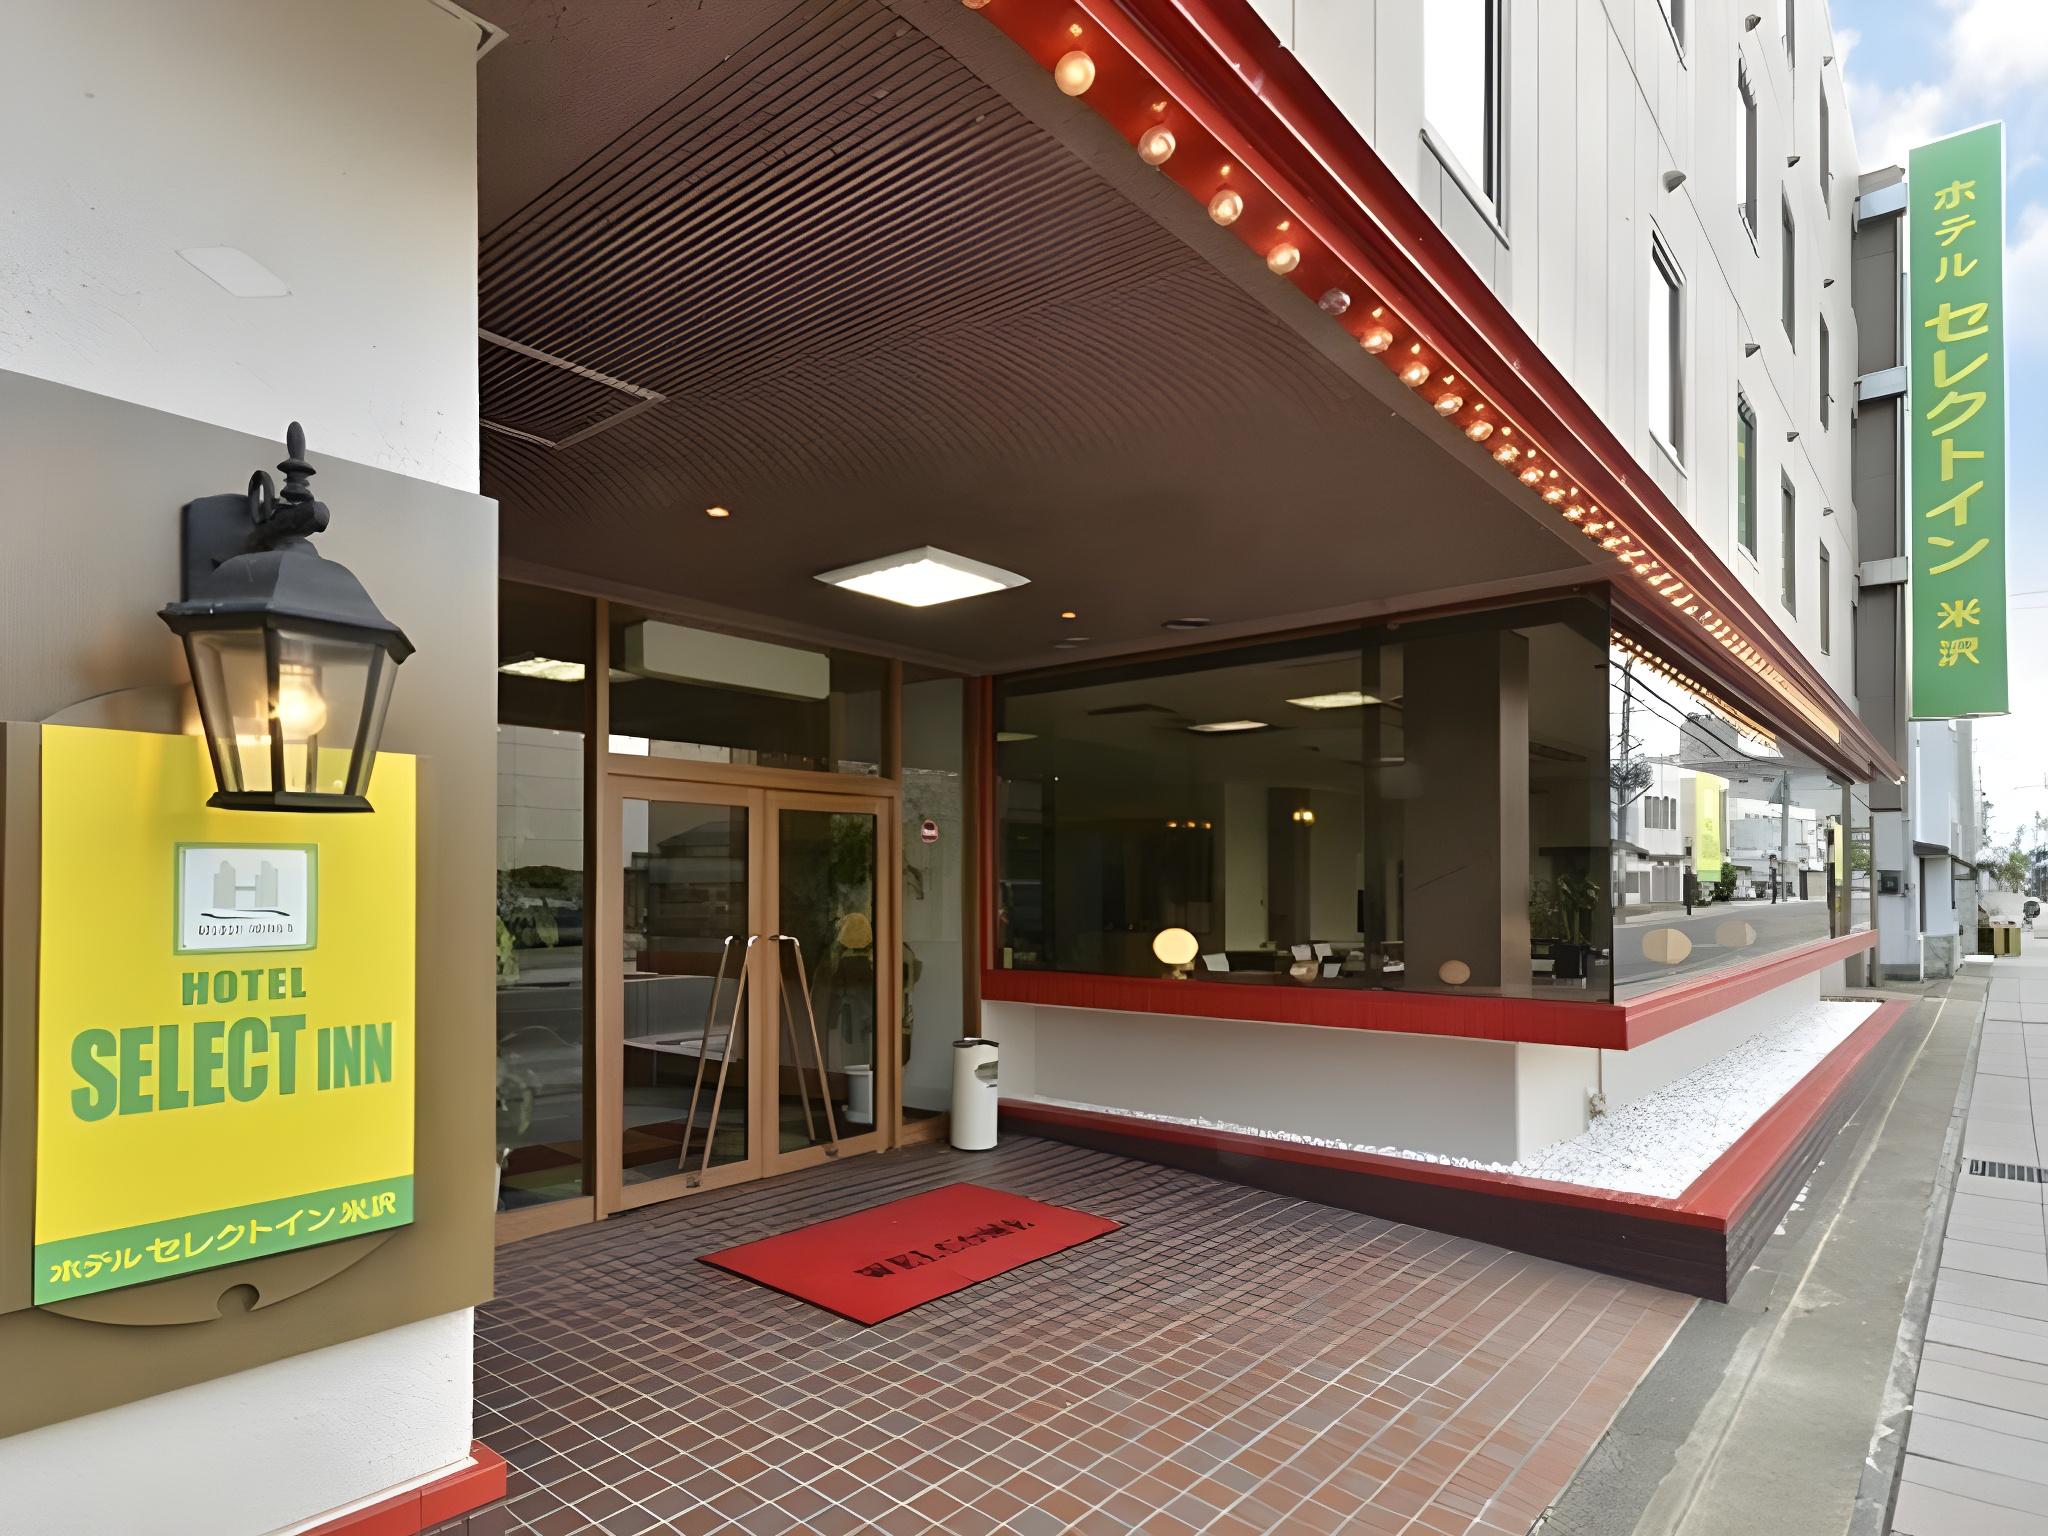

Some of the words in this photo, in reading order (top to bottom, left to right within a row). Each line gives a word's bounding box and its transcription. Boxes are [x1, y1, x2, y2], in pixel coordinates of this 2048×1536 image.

[1934, 180, 1979, 284] ホテル
[1924, 302, 1990, 575] セレクトイン
[181, 967, 307, 1006] HOTEL
[70, 1013, 306, 1123] SELECT
[317, 1022, 393, 1091] INN
